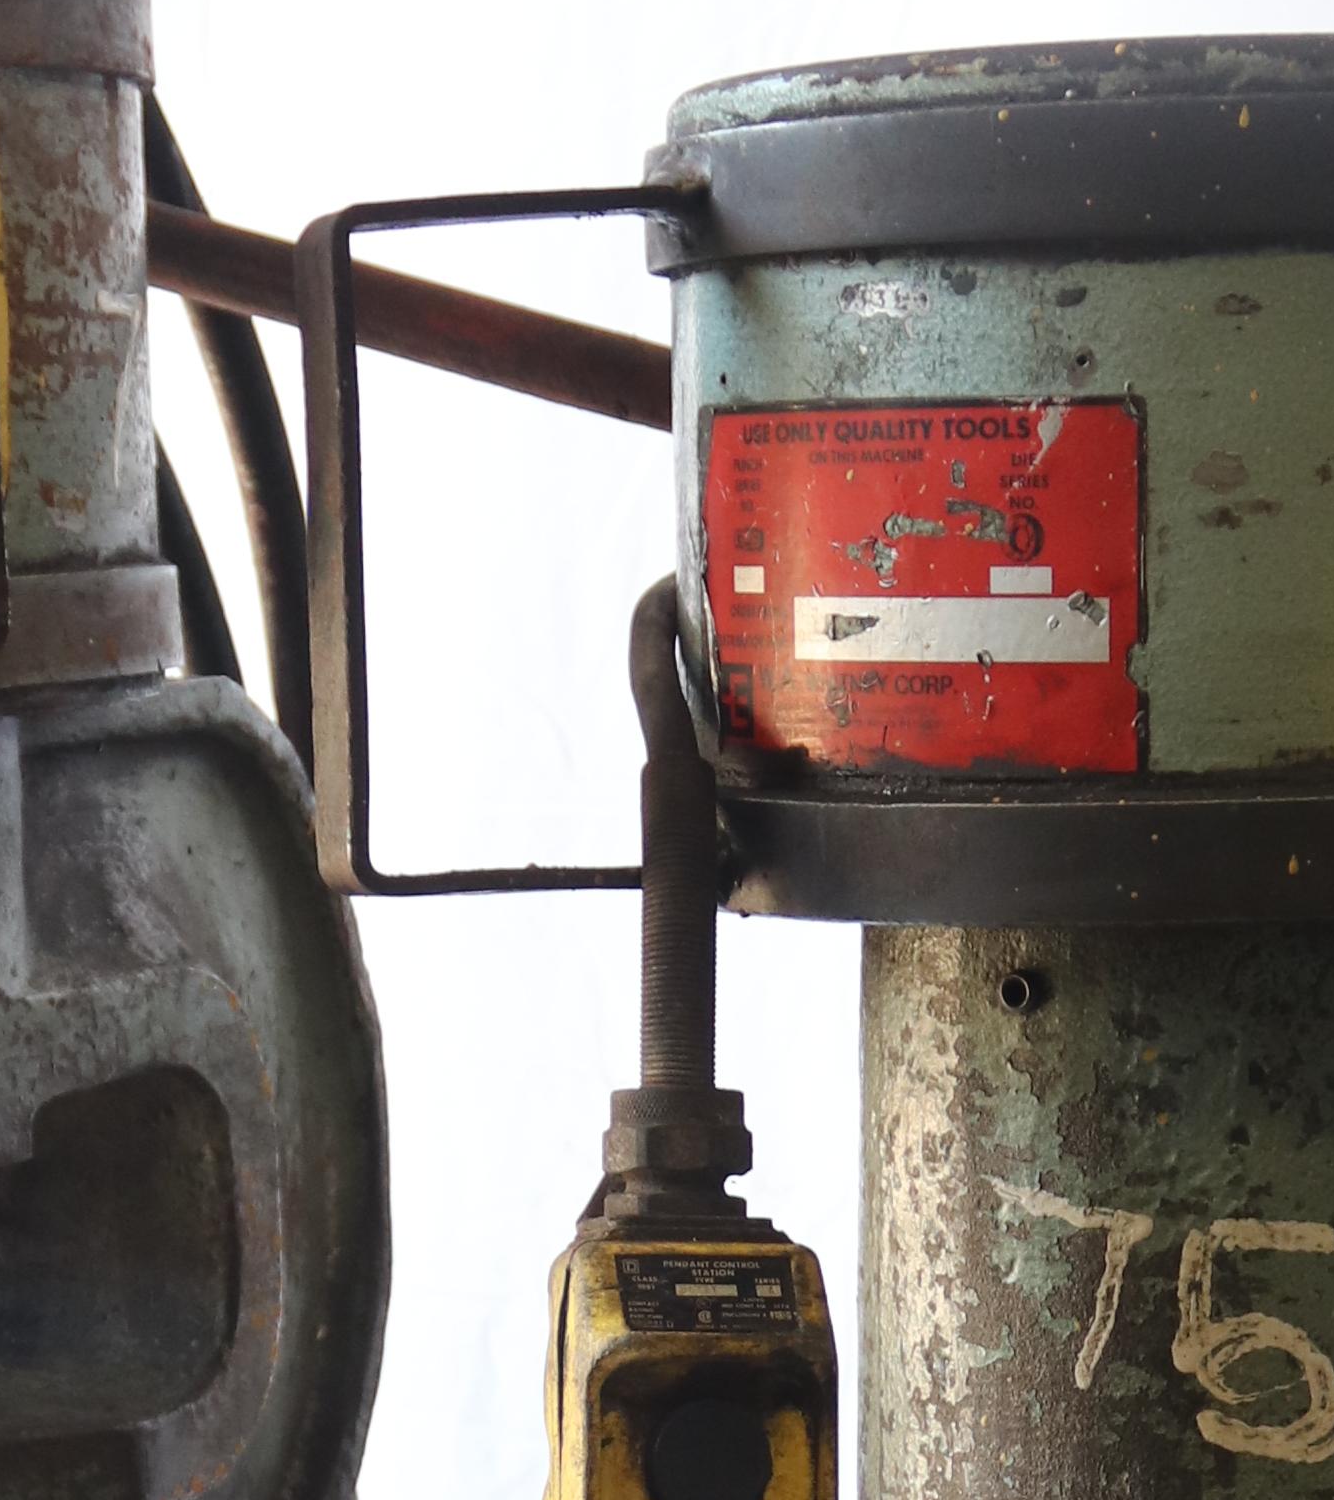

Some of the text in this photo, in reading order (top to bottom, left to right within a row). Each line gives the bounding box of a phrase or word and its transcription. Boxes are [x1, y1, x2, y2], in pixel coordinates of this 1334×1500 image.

[742, 417, 1031, 444] USE ONLY QUALITY TOOLS
[809, 447, 924, 464] ON THIS MACHINE
[998, 473, 1049, 488] SERIES
[894, 674, 960, 696] CORP.
[662, 1260, 761, 1269] PENDANT CONTROL
[691, 1268, 735, 1277] STATION
